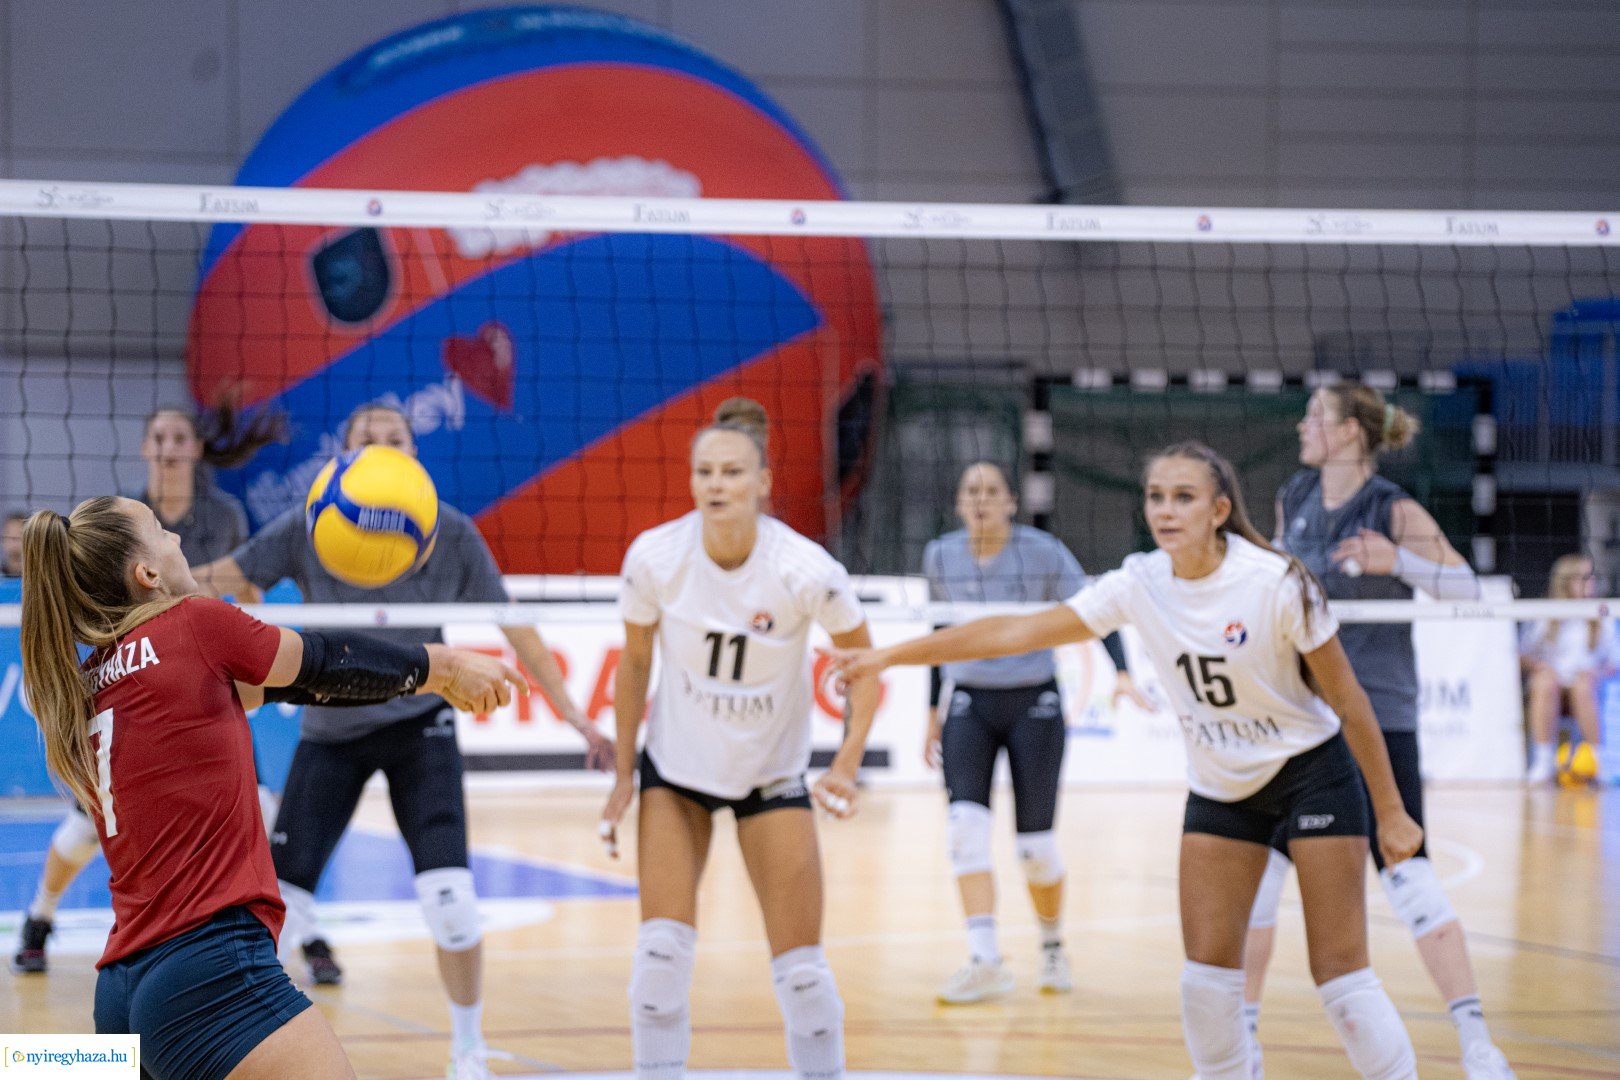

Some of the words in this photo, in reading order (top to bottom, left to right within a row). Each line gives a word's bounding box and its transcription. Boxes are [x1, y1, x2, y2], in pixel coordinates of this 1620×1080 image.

[706, 631, 748, 681] 11
[1175, 651, 1237, 709] 15
[87, 707, 119, 838] 7
